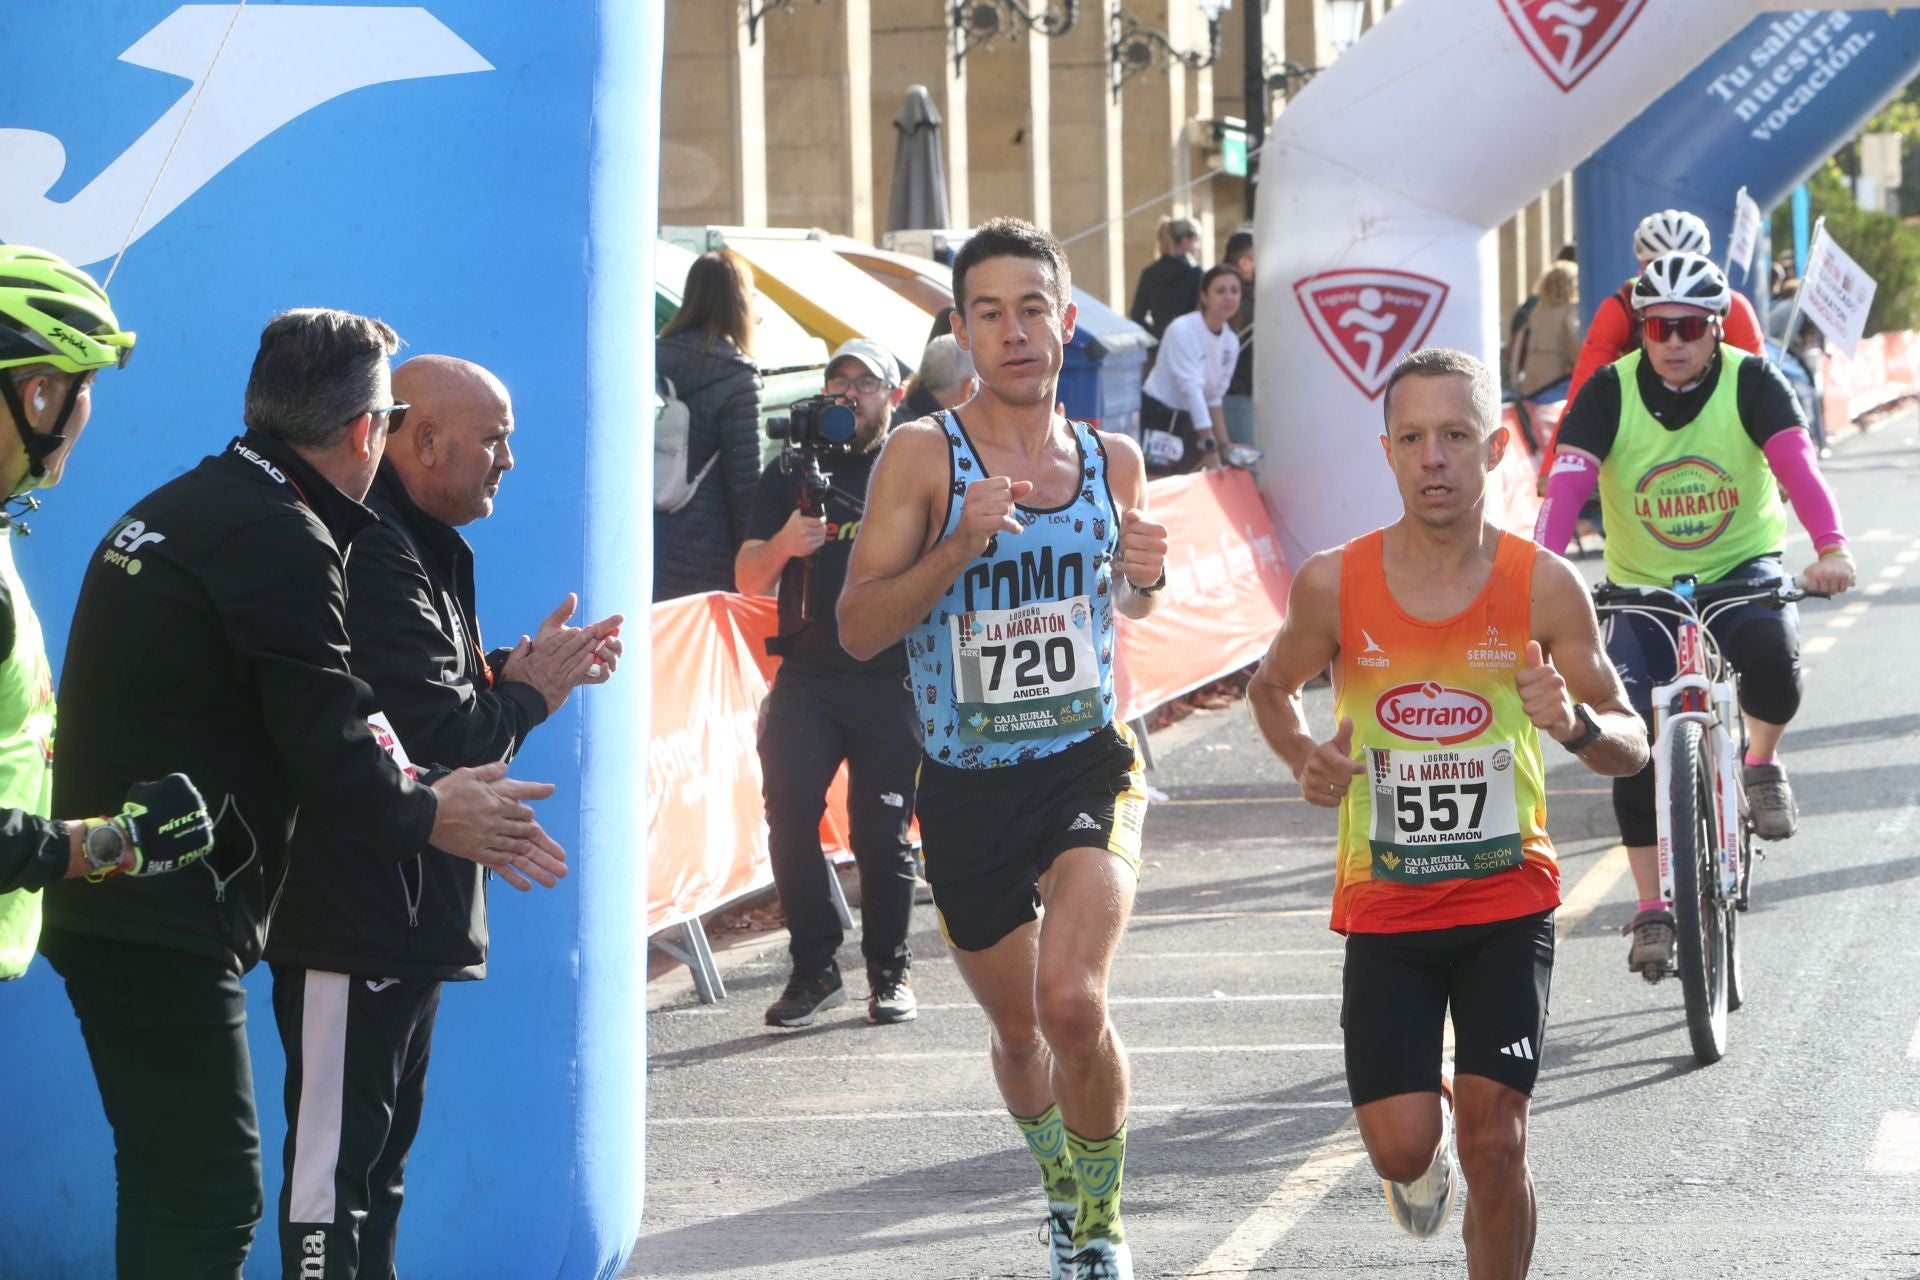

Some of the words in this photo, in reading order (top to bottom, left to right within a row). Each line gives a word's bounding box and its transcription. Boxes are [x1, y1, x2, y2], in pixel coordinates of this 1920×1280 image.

[1706, 65, 1753, 101] Tu
[1750, 10, 1818, 68] salu
[1734, 10, 1852, 121] nuestra
[1750, 31, 1876, 140] vocación.
[48, 327, 88, 357] Spiuk
[234, 442, 287, 484] HEAD
[1660, 483, 1706, 495] LOGROÑO
[1634, 495, 1652, 518] LA
[1657, 486, 1739, 519] MARATÓN
[1048, 514, 1071, 525] LOCA
[103, 549, 130, 568] sport
[964, 545, 1083, 612] COMO
[1010, 607, 1041, 621] LOGROÑO
[986, 623, 1003, 641] LA
[1006, 613, 1066, 639] MARATÓN
[960, 649, 979, 658] 42K
[1467, 649, 1517, 661] SERRANO
[980, 636, 1076, 691] 720
[1013, 686, 1050, 699] ANDER
[994, 713, 1018, 724] CAJA
[1019, 710, 1053, 722] RURAL
[1060, 711, 1094, 726] SOCIAL
[1387, 698, 1483, 727] Serrano
[994, 723, 1009, 733] DE
[1011, 718, 1058, 732] NAVARRA
[1423, 752, 1459, 763] LOGROÑO
[1400, 763, 1416, 782] LA
[1420, 758, 1484, 781] MARATÓN
[1376, 787, 1393, 795] 42K
[1396, 782, 1488, 833] 557
[1406, 833, 1437, 844] JUAN
[1439, 831, 1483, 842] RAMÓN
[1404, 857, 1428, 867] CAJA
[1429, 854, 1466, 865] RURAL
[1474, 848, 1513, 861] ACCIÓN
[1404, 865, 1419, 875] DE
[1421, 861, 1470, 874] NAVARRA
[1474, 859, 1513, 870] SOCIAL
